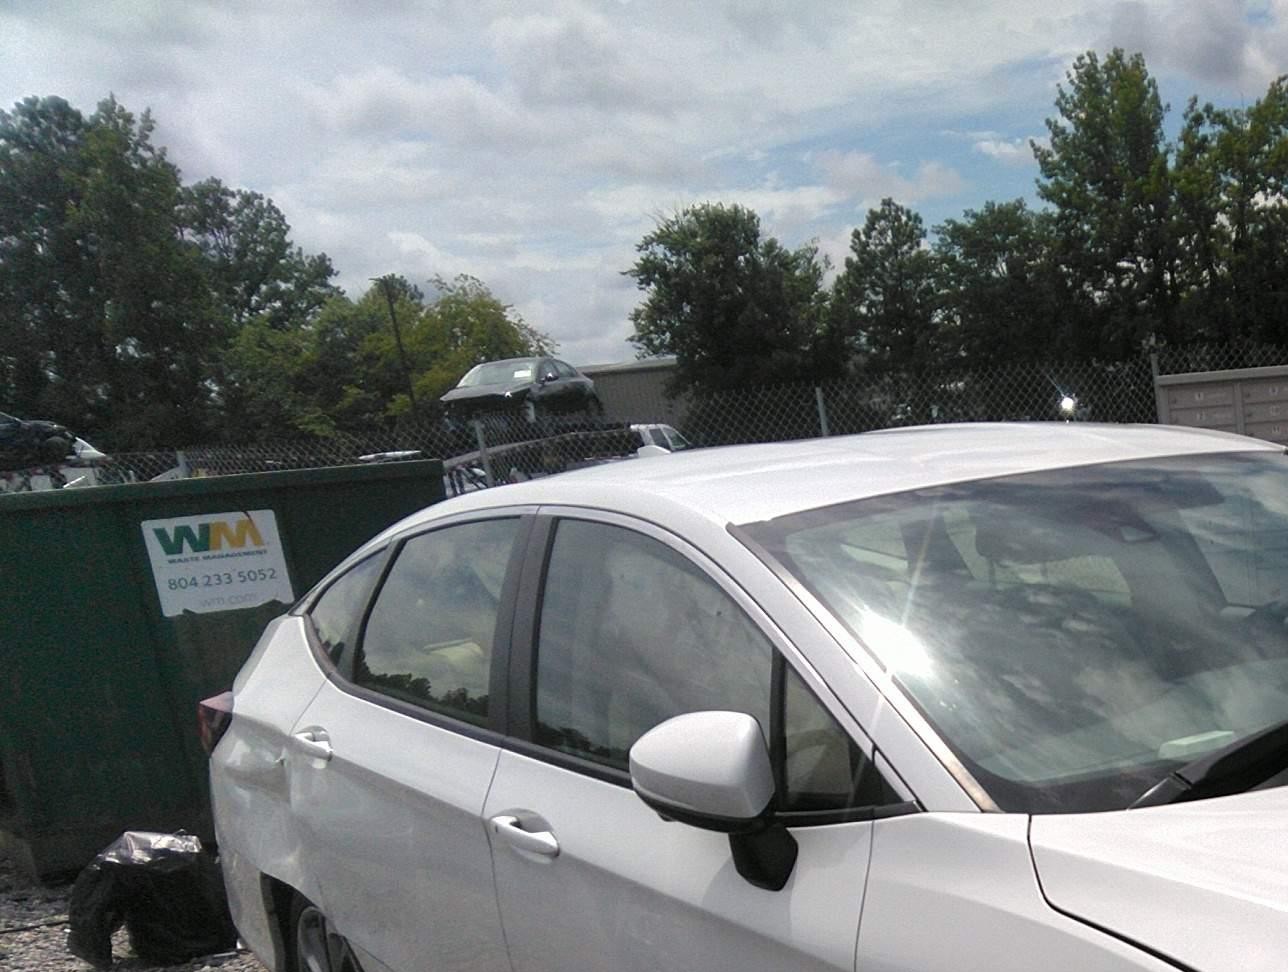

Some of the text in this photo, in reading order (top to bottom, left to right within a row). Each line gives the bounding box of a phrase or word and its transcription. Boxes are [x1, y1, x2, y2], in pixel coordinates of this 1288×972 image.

[152, 519, 265, 556] WM
[167, 567, 278, 591] 804 233 5052
